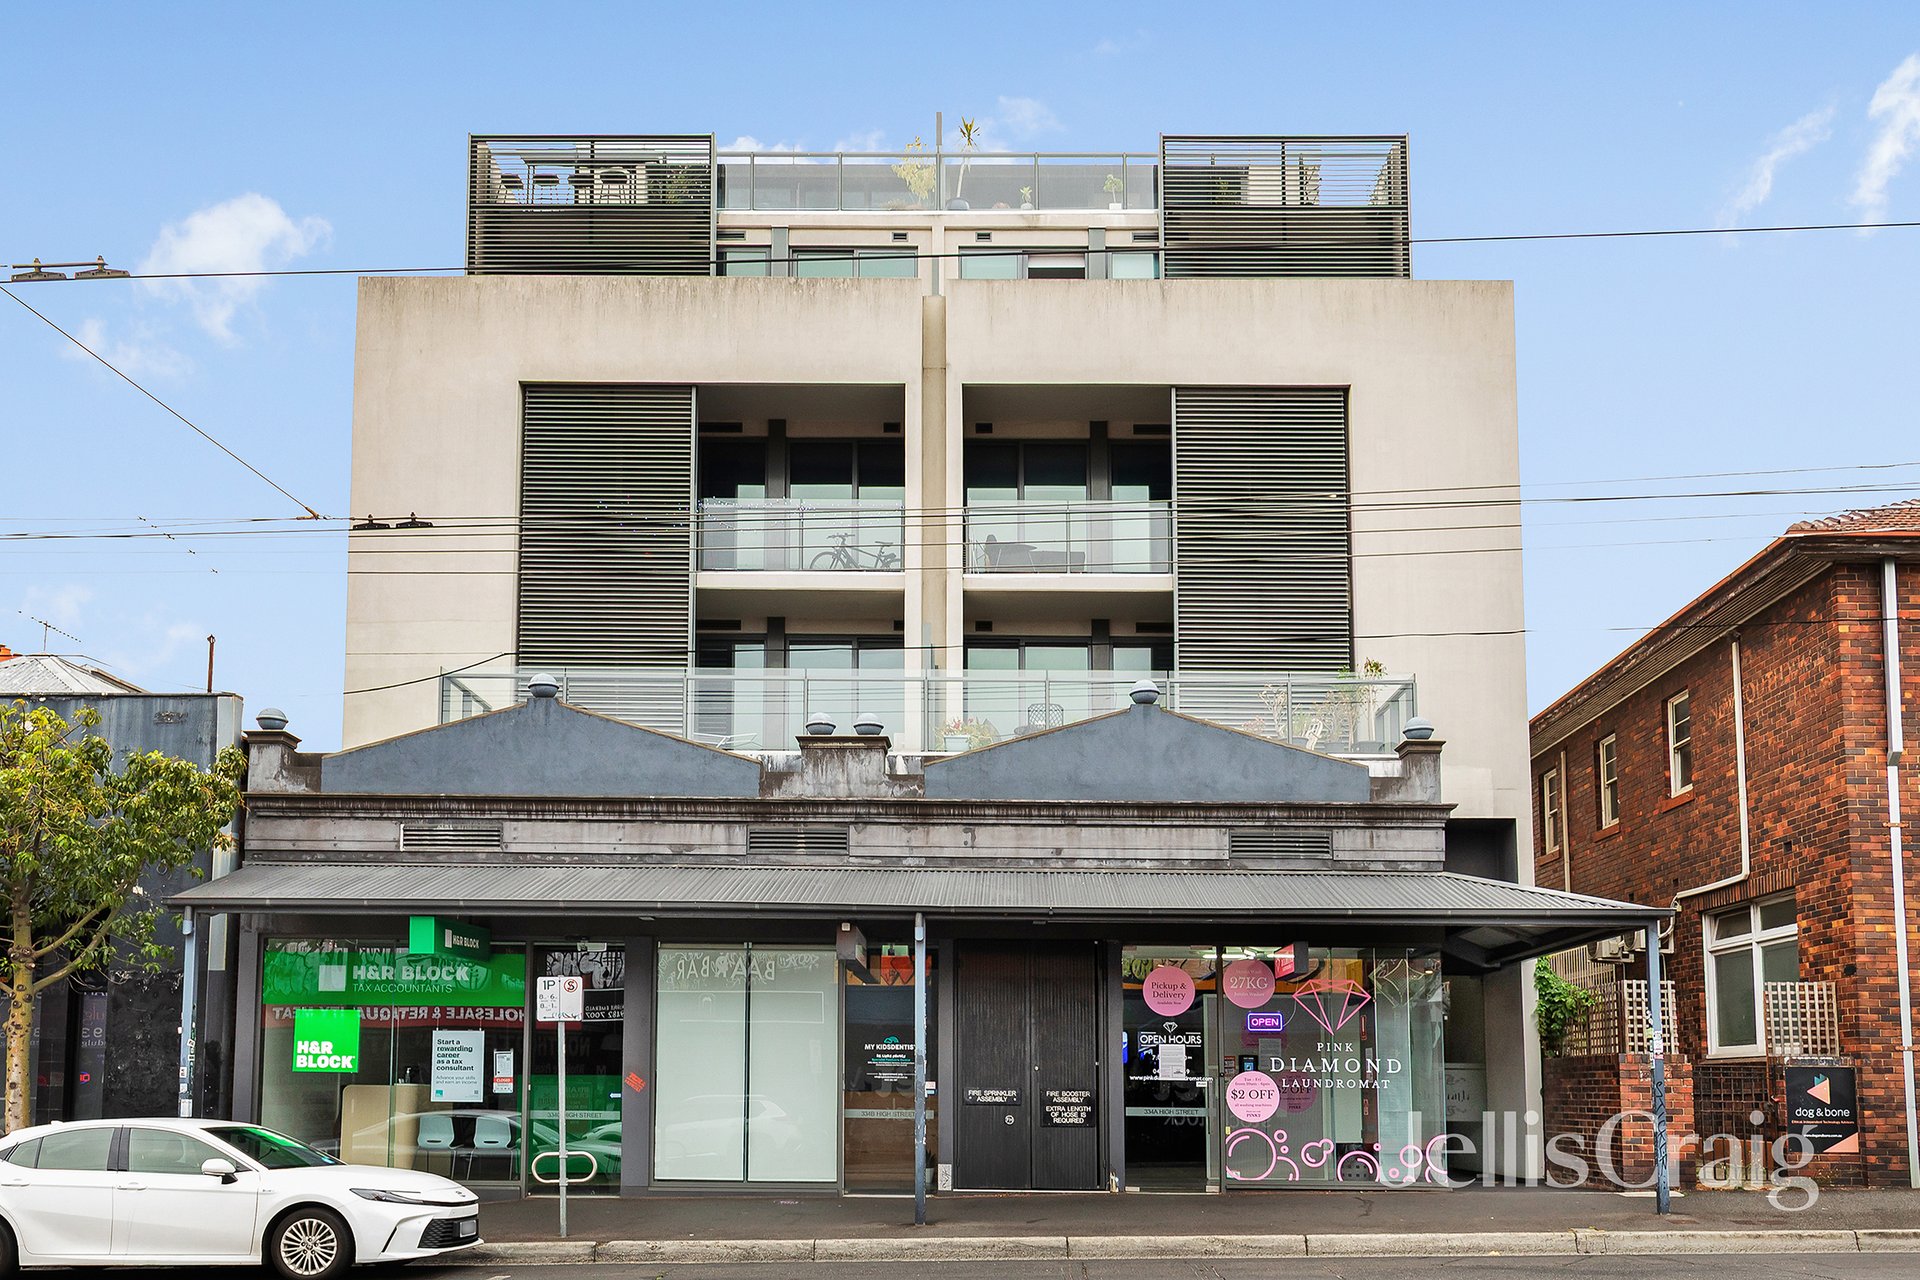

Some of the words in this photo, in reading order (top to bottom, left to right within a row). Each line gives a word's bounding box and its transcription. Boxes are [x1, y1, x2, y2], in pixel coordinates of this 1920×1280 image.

[463, 936, 480, 949] BLOCK
[352, 964, 394, 981] H&R
[401, 965, 470, 981] BLOCK
[542, 980, 556, 990] 1P
[1151, 982, 1178, 991] Pickup
[1179, 982, 1187, 990] &
[1229, 976, 1268, 989] 27KG
[353, 983, 372, 993] TAX
[374, 983, 453, 994] ACCOUNTANTS
[1152, 991, 1187, 1000] Delivery
[1251, 1018, 1279, 1027] OPEN
[1140, 1034, 1166, 1044] OPEN
[1169, 1035, 1202, 1045] HOURS
[297, 1041, 333, 1054] H&R
[1317, 1043, 1353, 1051] PINK
[296, 1055, 353, 1068] BLOCK
[1270, 1058, 1401, 1074] DIAMOND
[1282, 1079, 1390, 1089] LAUNDROMAT
[1231, 1089, 1245, 1100] $2
[1248, 1090, 1275, 1099] OFF
[1795, 1107, 1814, 1118] dog
[1816, 1108, 1824, 1117] &
[1825, 1107, 1850, 1117] bone
